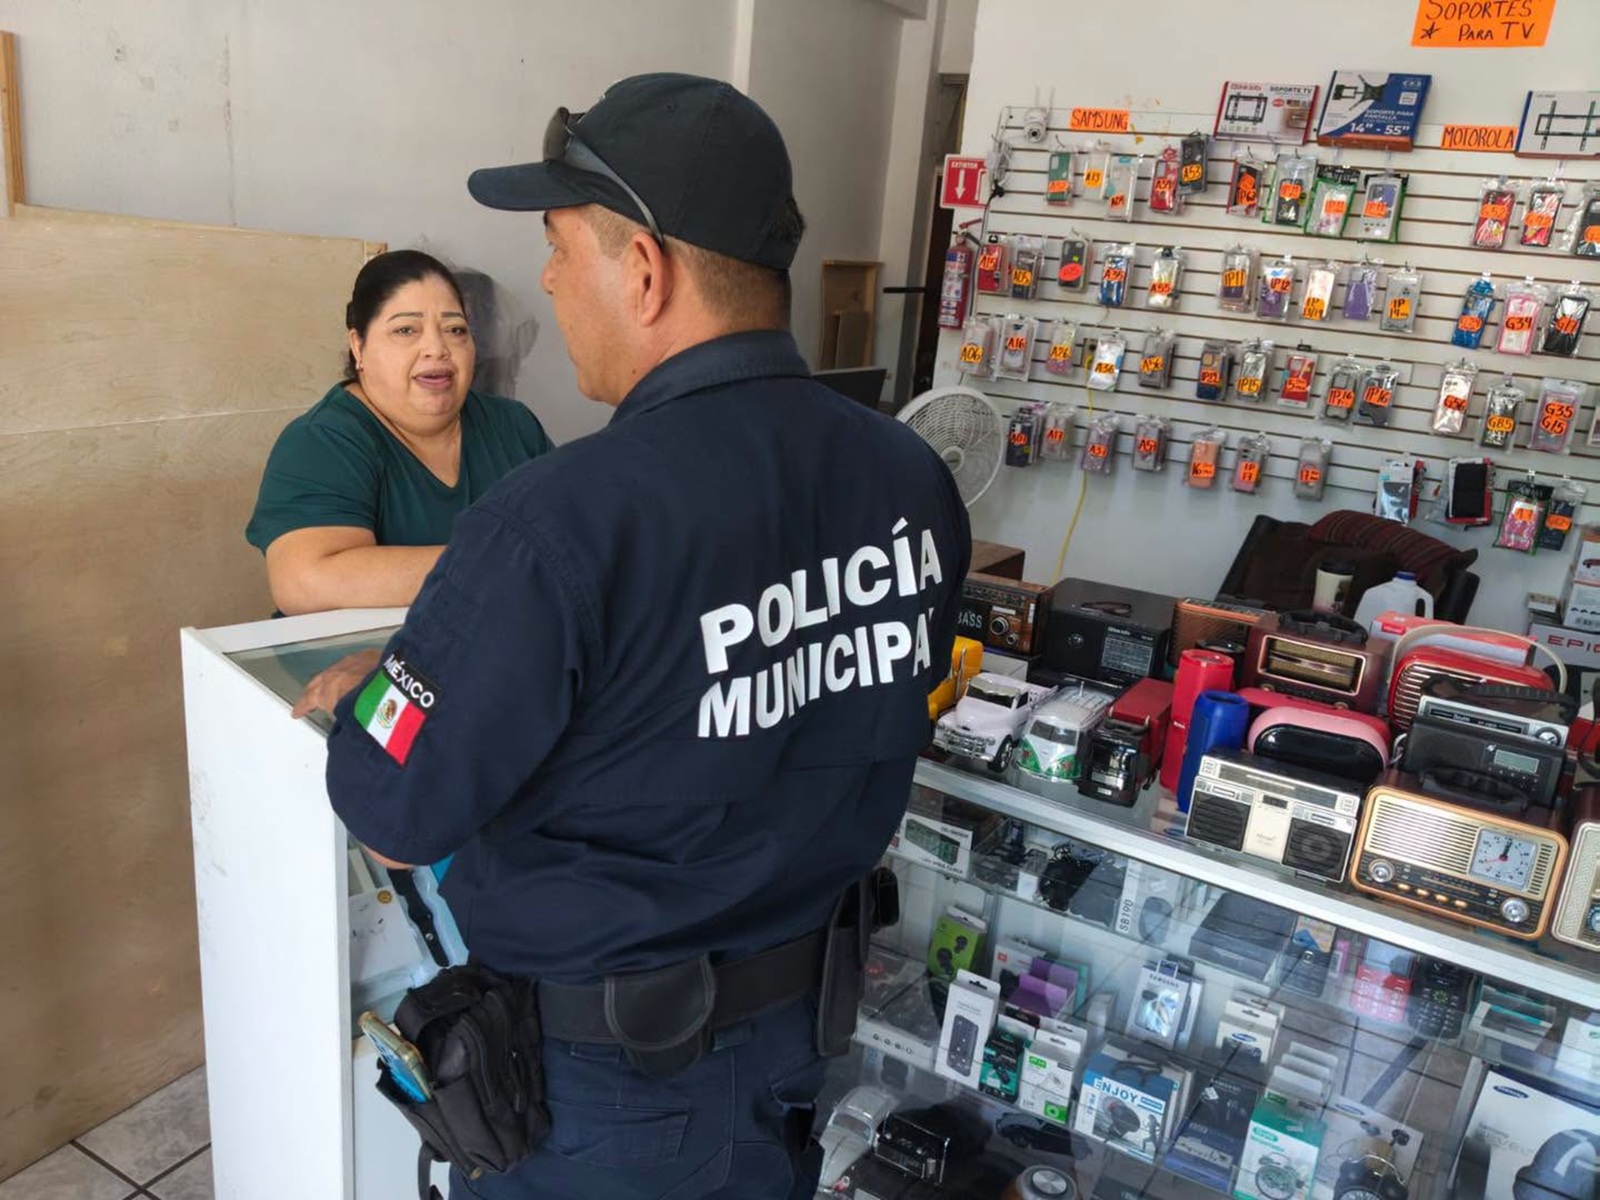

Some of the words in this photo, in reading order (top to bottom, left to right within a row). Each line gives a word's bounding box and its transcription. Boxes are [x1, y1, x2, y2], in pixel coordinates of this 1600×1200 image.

[1425, 0, 1532, 20] SOPORTES
[1500, 21, 1535, 40] TV
[1072, 110, 1128, 128] SAMSUNG
[1444, 127, 1514, 149] MOTOROLA
[1505, 316, 1532, 330] G34
[961, 346, 981, 361] A06
[1237, 378, 1259, 392] IP15
[1546, 403, 1574, 418] G35
[700, 517, 942, 674] POLICÍA
[383, 654, 435, 708] MÉXICO
[698, 607, 934, 738] MUNICIPA
[1119, 899, 1134, 933] SB190
[1093, 1078, 1139, 1104] ENJOY
